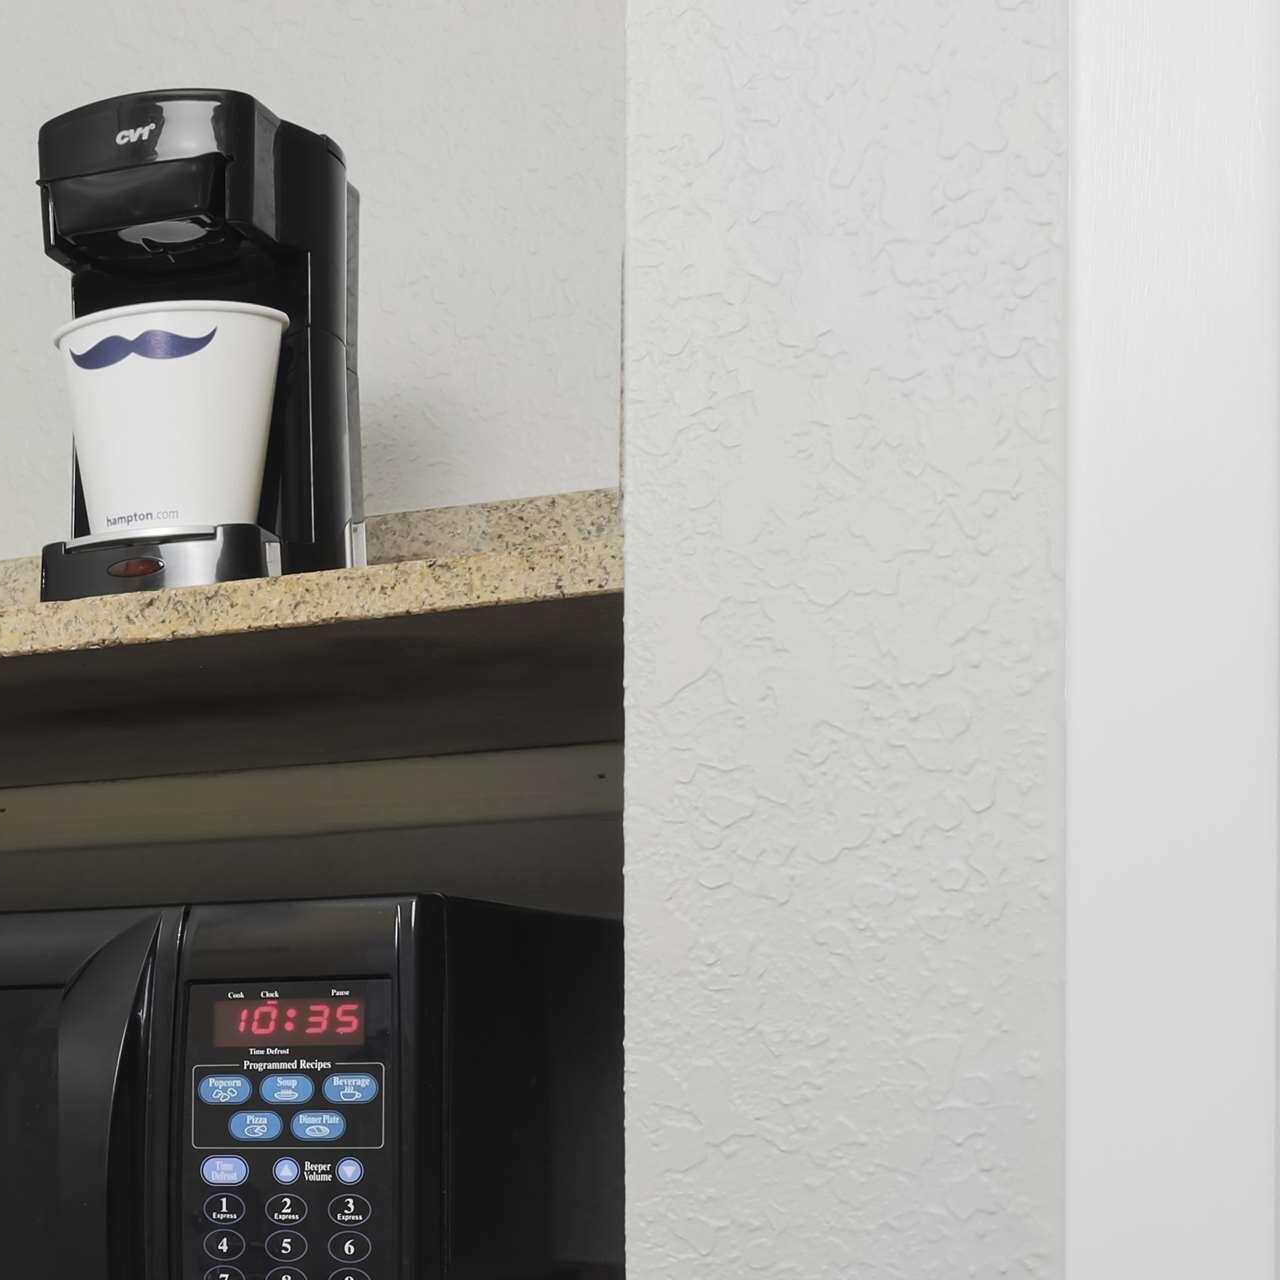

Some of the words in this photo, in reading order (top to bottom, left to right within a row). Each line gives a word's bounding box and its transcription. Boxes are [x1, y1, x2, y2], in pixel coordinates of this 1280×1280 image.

[106, 508, 179, 528] hampton.com
[228, 991, 245, 999] Cook
[260, 990, 279, 998] Clock
[239, 1004, 359, 1034] 10:35
[243, 1060, 298, 1071] Programmed
[300, 1059, 332, 1071] Recipes
[208, 1078, 242, 1088] Popcorn
[276, 1077, 297, 1089] Soup
[333, 1076, 370, 1087] Beverage
[246, 1115, 267, 1125] Pizza
[305, 1161, 331, 1173] Beeper
[304, 1172, 332, 1182] Volume
[220, 1197, 228, 1212] 1
[281, 1197, 291, 1213] 2
[344, 1198, 354, 1213] 3
[212, 1212, 237, 1220] Express
[337, 1213, 362, 1221] Express
[217, 1237, 228, 1252] 4
[281, 1238, 292, 1254] 5
[344, 1239, 355, 1255] 6
